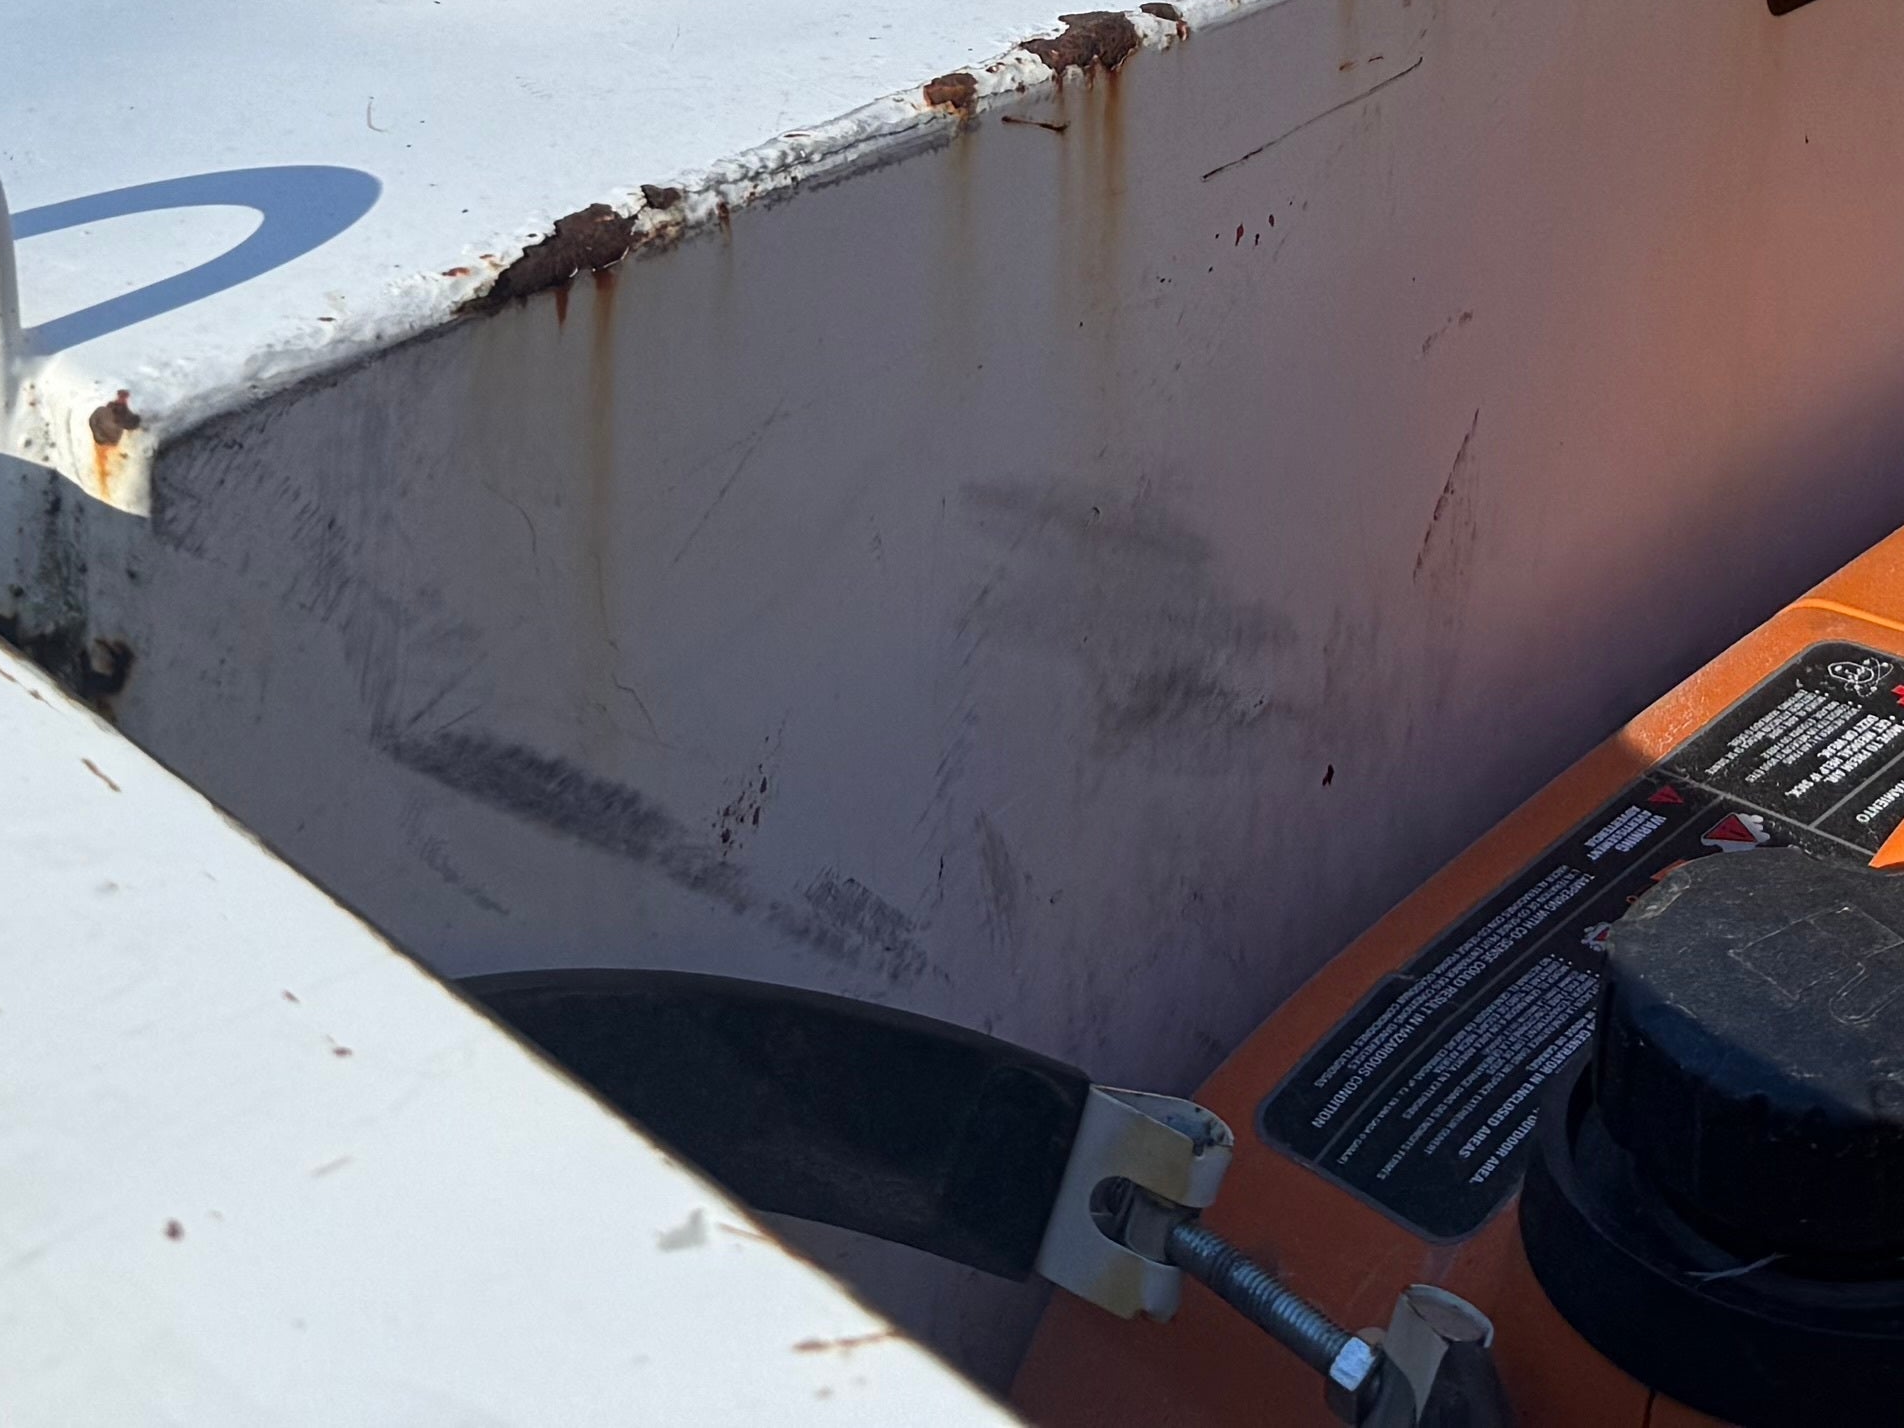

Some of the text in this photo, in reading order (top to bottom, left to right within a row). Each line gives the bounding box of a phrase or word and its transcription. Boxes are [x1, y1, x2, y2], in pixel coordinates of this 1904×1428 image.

[1871, 718, 1891, 732] GET
[1837, 730, 1876, 758] MEDICAL
[1865, 741, 1883, 751] TO
[1816, 757, 1842, 774] HELP
[1841, 749, 1871, 771] FRESH
[1613, 814, 1666, 852] WARNING
[1541, 872, 1596, 912] TAMPERING
[1519, 908, 1551, 929] WITH
[1479, 925, 1530, 963] CO-SENSE
[1450, 960, 1488, 987] COULD
[1418, 984, 1458, 1015] RESULT
[1407, 1011, 1426, 1025] IN
[1358, 1023, 1414, 1076] HAZARDOUS
[1310, 1074, 1363, 1129] CONDITION
[1456, 1028, 1593, 1159] GENERATOR IN ENCLOSED AREAS
[1467, 1154, 1501, 1187] AREA.
